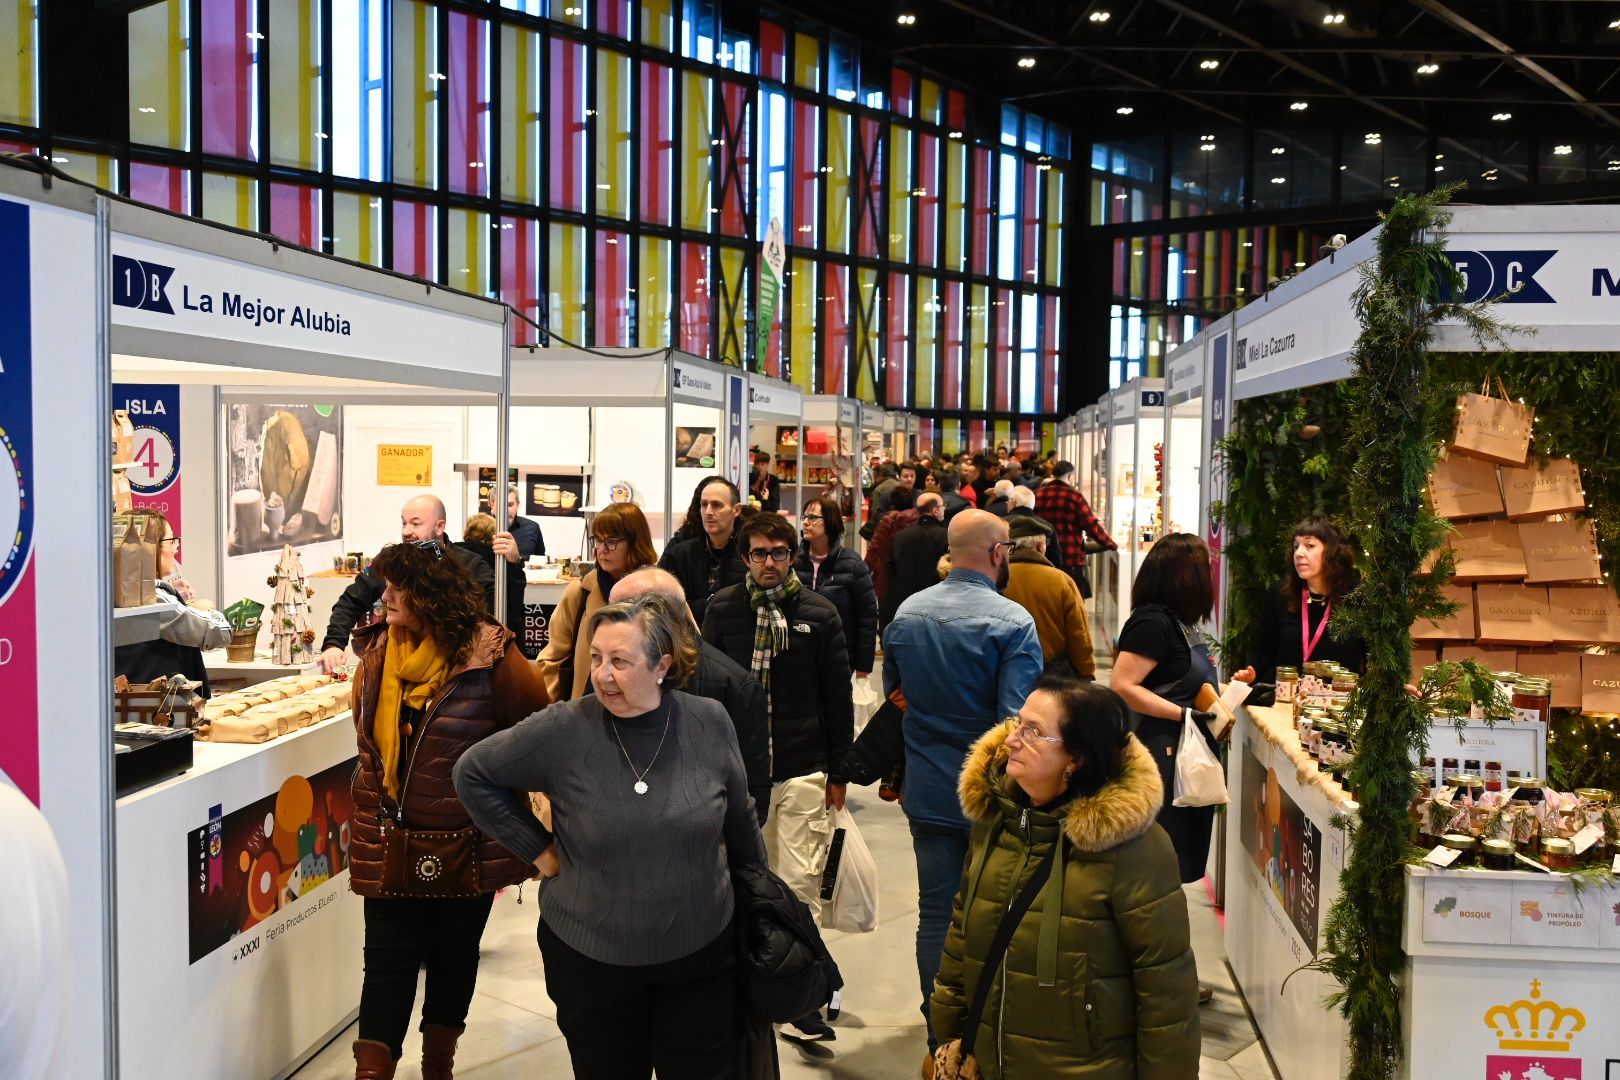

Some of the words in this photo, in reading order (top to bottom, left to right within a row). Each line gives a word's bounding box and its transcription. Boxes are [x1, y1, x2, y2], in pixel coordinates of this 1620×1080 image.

[1455, 262, 1469, 293] 5
[1506, 261, 1523, 293] C
[125, 268, 131, 297] 1
[152, 273, 159, 302] B
[183, 285, 213, 313] La
[222, 292, 285, 326] Mejor
[290, 306, 351, 336] Alubia
[1261, 340, 1269, 359] La
[1269, 333, 1295, 356] Cazurra
[1148, 393, 1155, 404] 6
[126, 399, 166, 415] ISLA
[133, 437, 159, 478] 4
[381, 447, 424, 457] GANADOR
[524, 603, 543, 614] SA
[525, 616, 546, 627] BO
[1302, 842, 1313, 874] BO
[1301, 871, 1315, 908] RES
[1459, 911, 1492, 919] BOSQUE
[1546, 912, 1574, 920] TINTURA
[1575, 912, 1584, 920] DE
[239, 936, 260, 959] XXXI
[265, 922, 285, 940] Feria
[286, 903, 318, 931] Productos
[1548, 919, 1582, 928] PROPÓLEO
